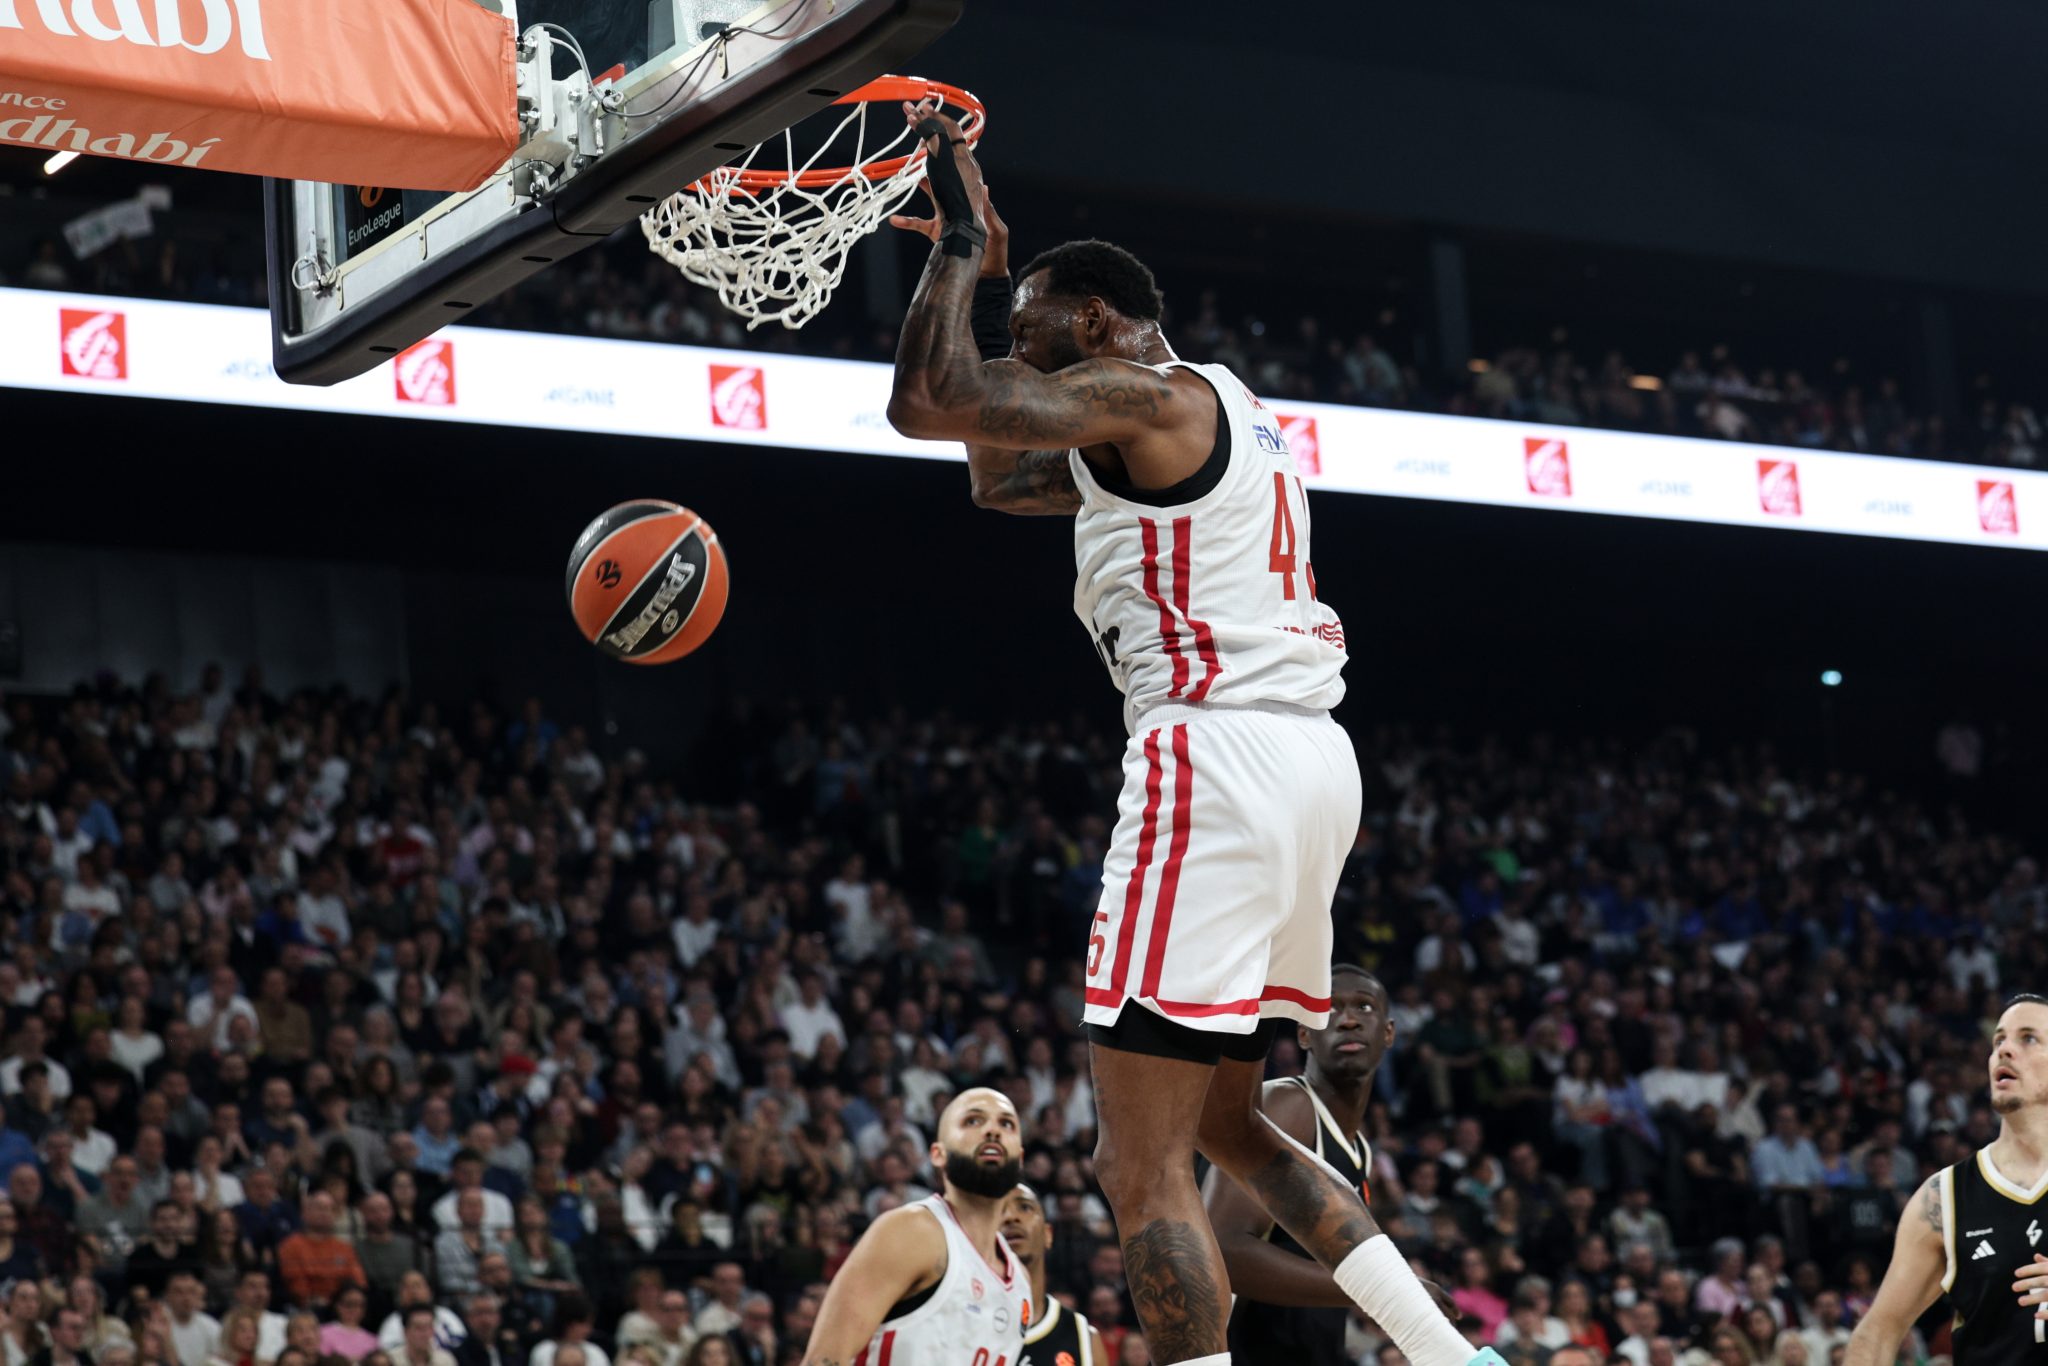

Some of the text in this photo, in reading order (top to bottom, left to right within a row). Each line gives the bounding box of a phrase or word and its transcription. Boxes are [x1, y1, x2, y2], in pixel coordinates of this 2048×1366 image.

[348, 202, 401, 246] EuroLeague
[1269, 471, 1317, 602] 4
[604, 552, 696, 653] SPALDING
